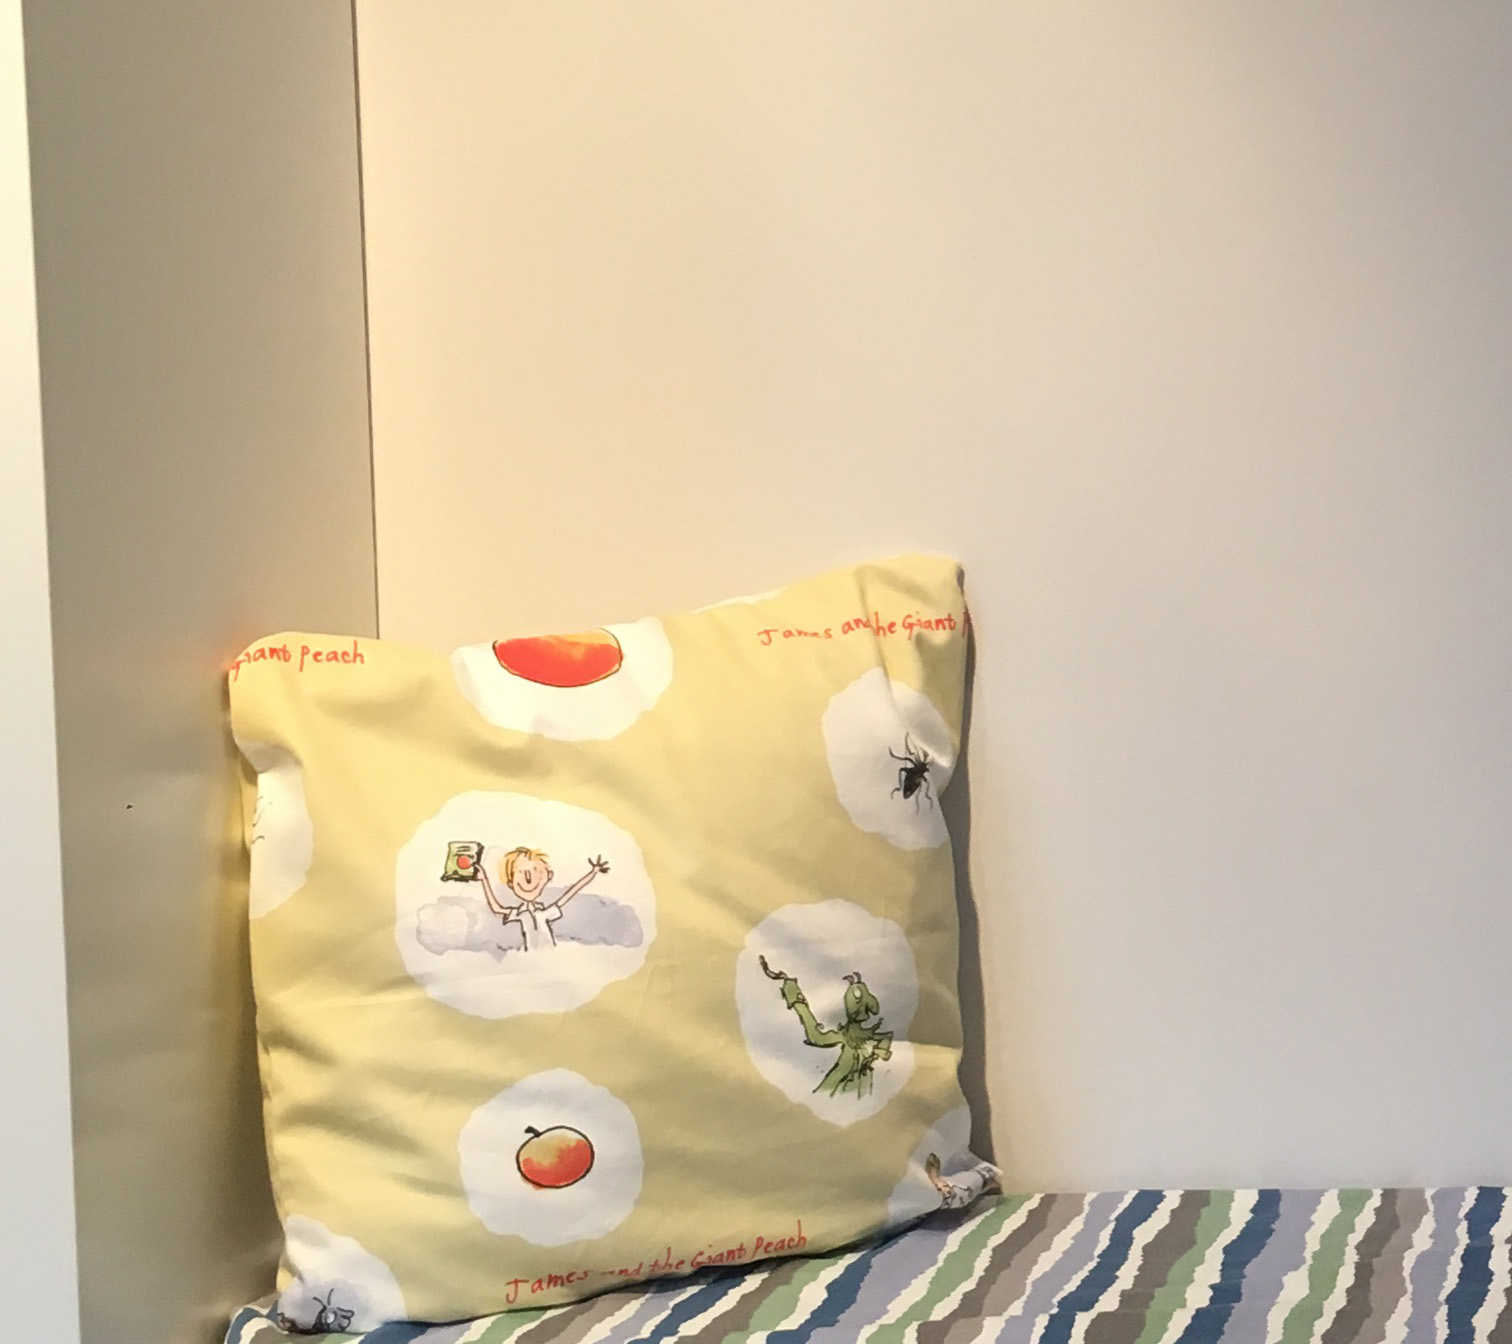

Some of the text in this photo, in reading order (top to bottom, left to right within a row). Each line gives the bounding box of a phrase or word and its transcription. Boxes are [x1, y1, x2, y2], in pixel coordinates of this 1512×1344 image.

[758, 629, 832, 646] James
[874, 611, 896, 637] he
[902, 611, 956, 640] Giant
[300, 640, 364, 672] Peach
[506, 1219, 807, 1303] James the Giant Peach
